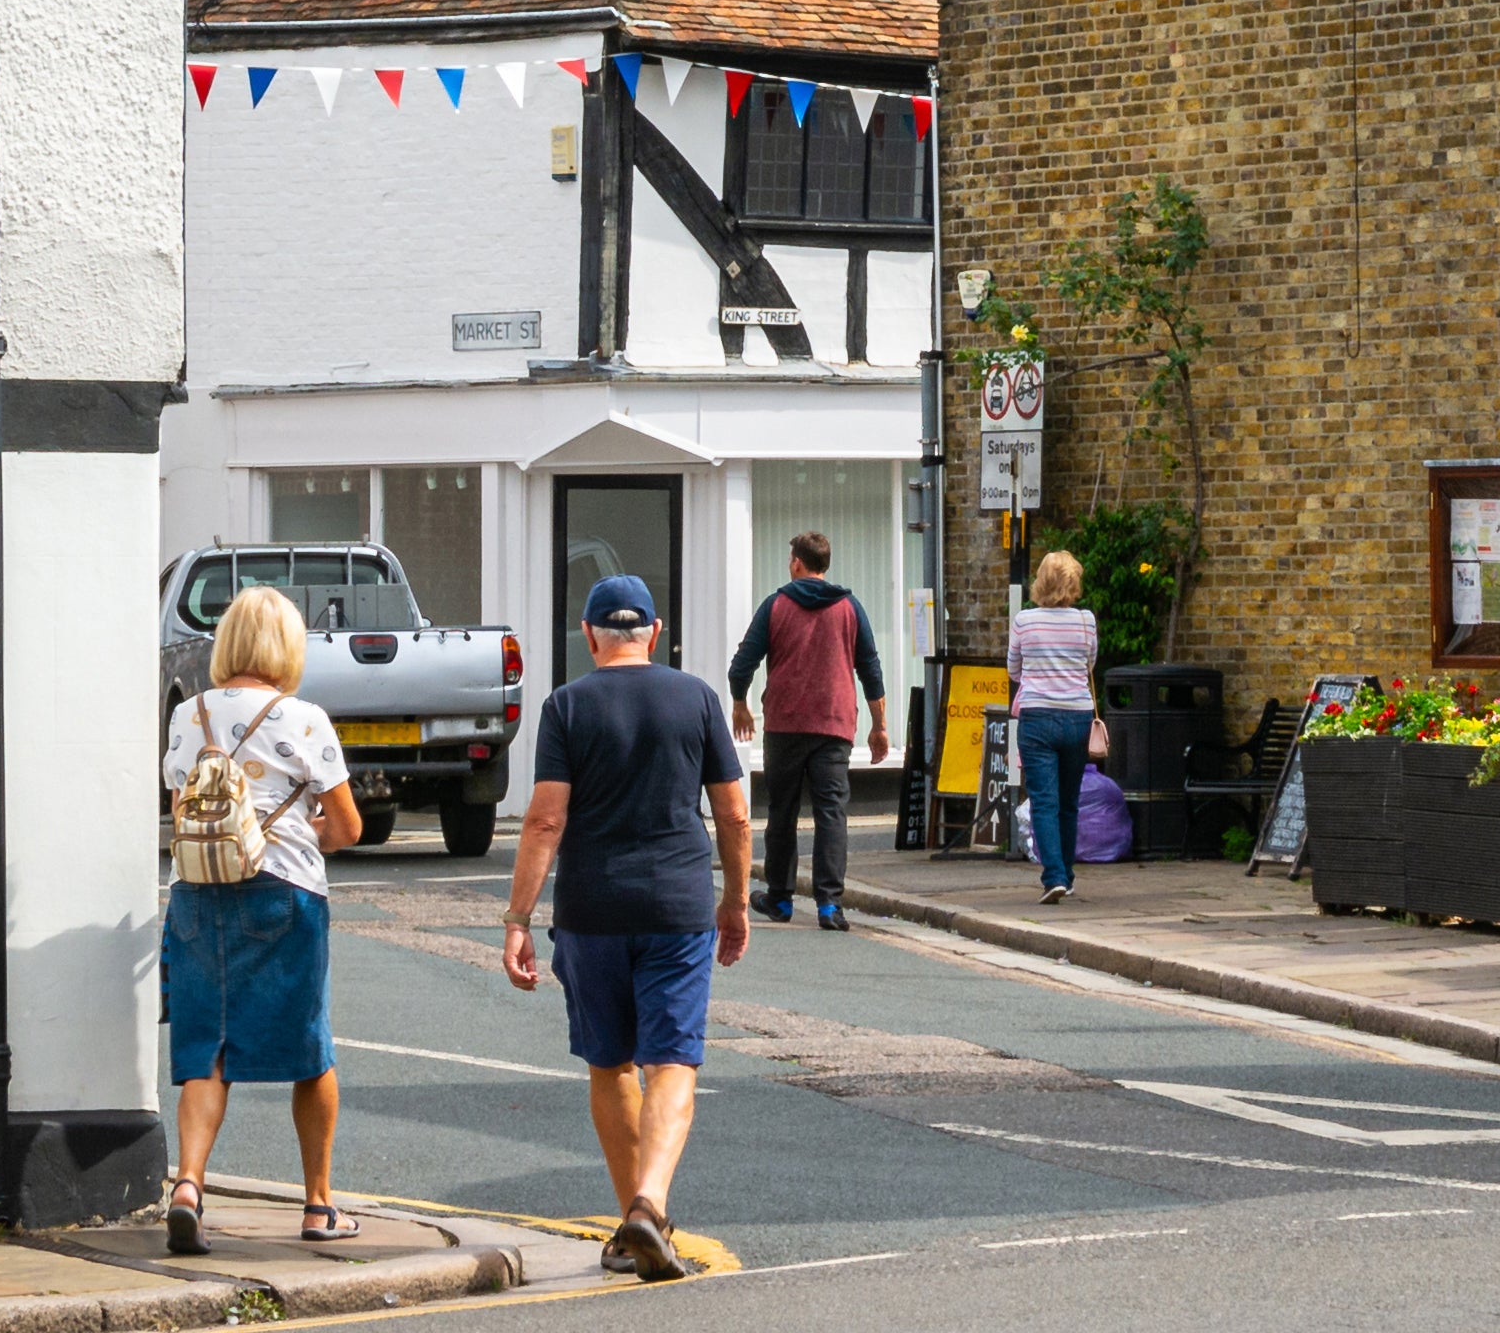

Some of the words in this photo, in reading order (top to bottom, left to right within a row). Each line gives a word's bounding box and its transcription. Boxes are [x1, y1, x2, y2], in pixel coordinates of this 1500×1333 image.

[724, 310, 751, 322] KING
[757, 310, 799, 323] STREET
[454, 321, 512, 342] MARKET
[520, 320, 539, 340] ST.
[987, 439, 1036, 456] Saturdays
[971, 680, 998, 694] KING
[947, 704, 984, 719] CLOSE
[988, 721, 1008, 745] THE
